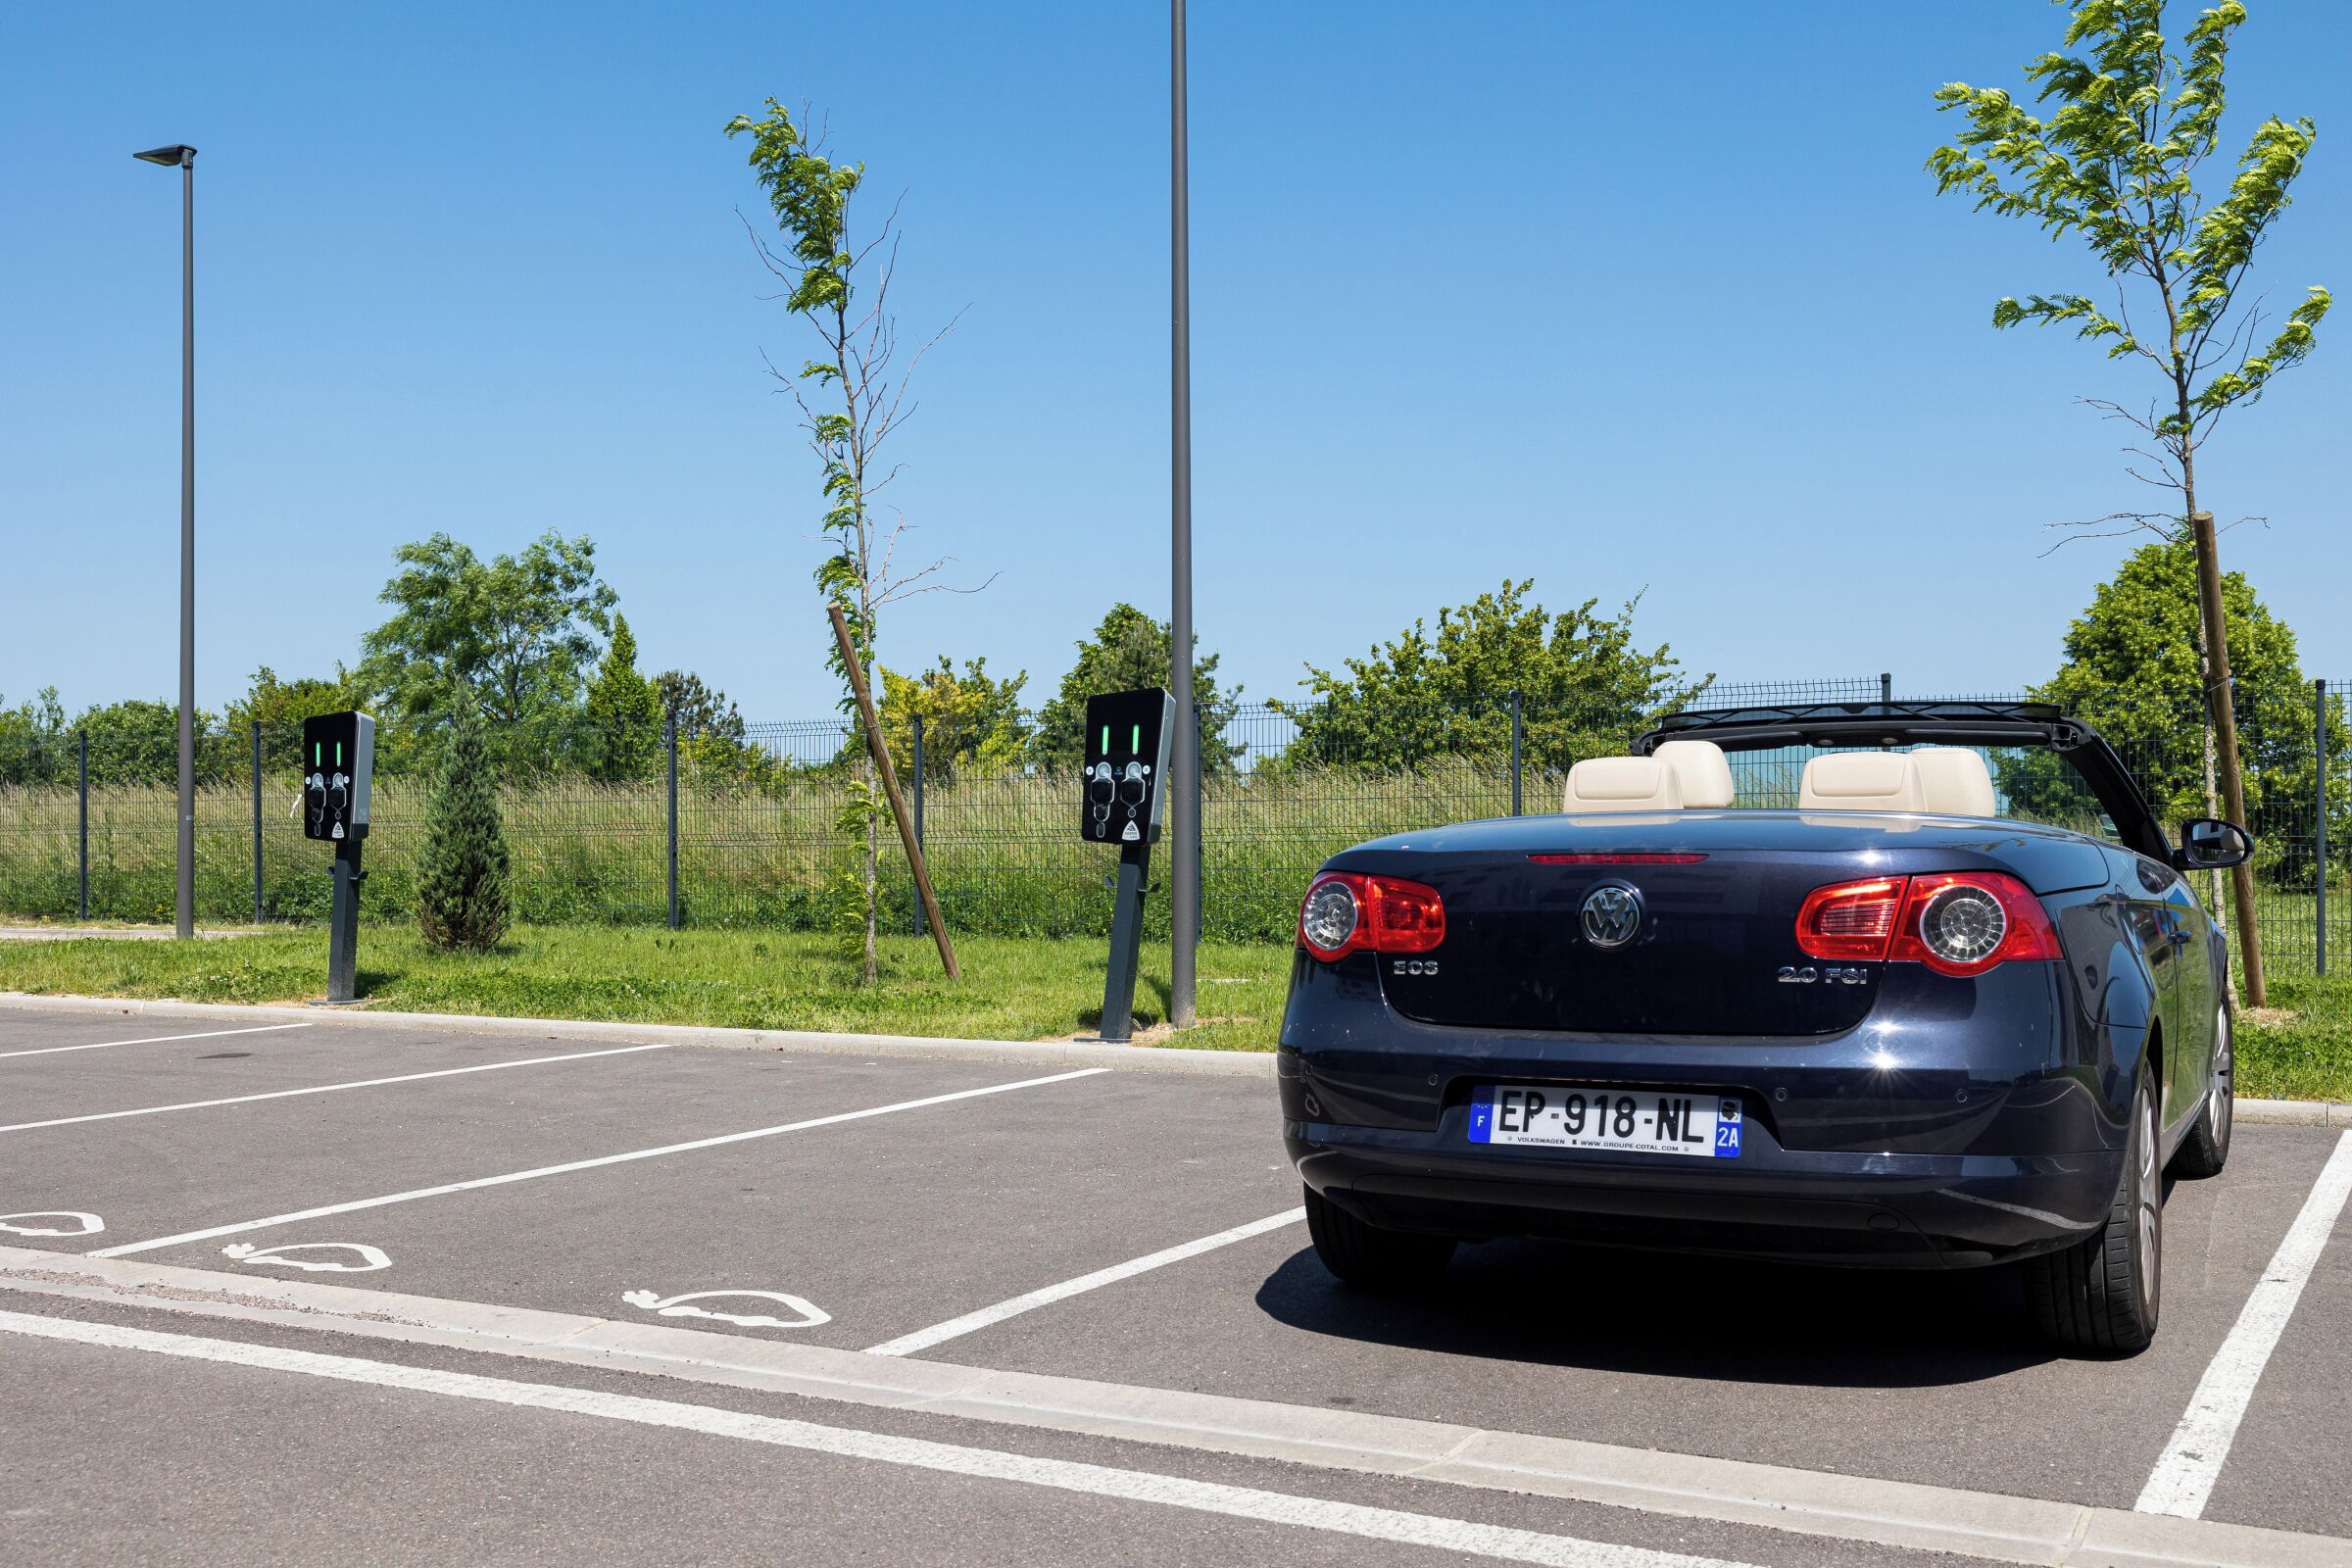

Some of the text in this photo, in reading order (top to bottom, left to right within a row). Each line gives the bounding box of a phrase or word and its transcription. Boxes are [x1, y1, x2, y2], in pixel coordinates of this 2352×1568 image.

[1394, 960, 1439, 975] EOS
[1825, 967, 1867, 985] FSI
[1477, 1115, 1486, 1127] F
[1498, 1090, 1704, 1144] EP-918-NL
[1717, 1126, 1740, 1148] 2A
